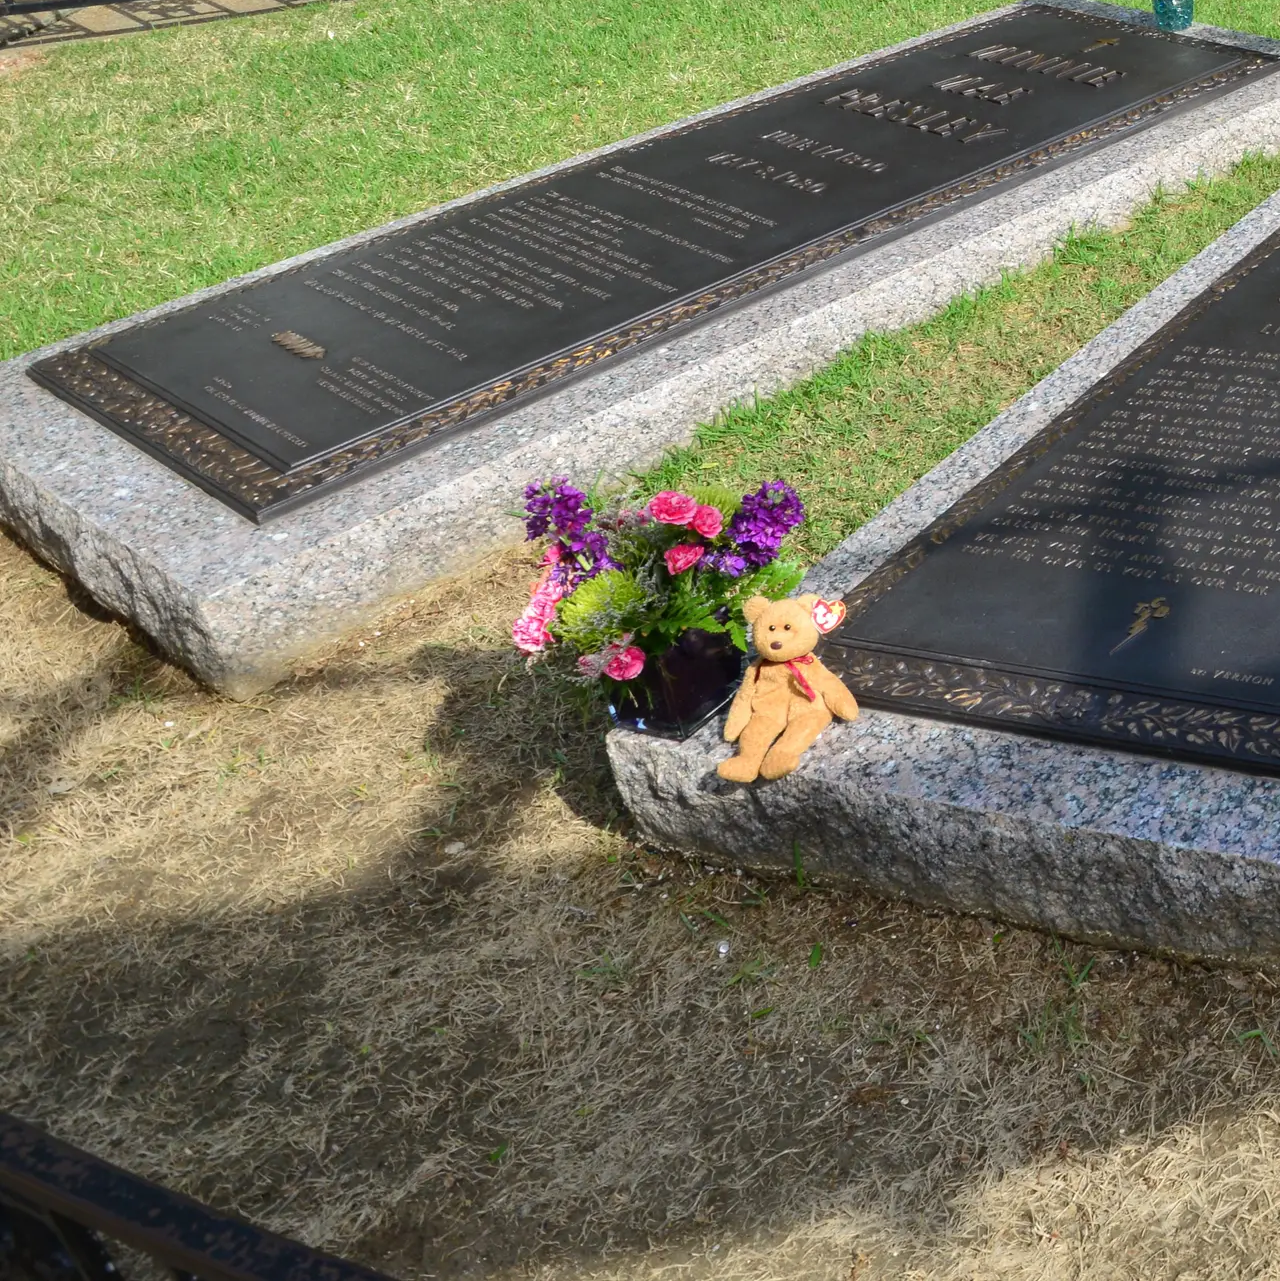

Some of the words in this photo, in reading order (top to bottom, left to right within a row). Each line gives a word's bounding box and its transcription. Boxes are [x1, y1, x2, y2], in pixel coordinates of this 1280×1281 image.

[969, 44, 1127, 88] MINNIE
[932, 73, 1033, 106] MAE
[824, 88, 1009, 144] PRESLEY
[814, 604, 839, 629] ty
[1213, 669, 1274, 687] VERNON
